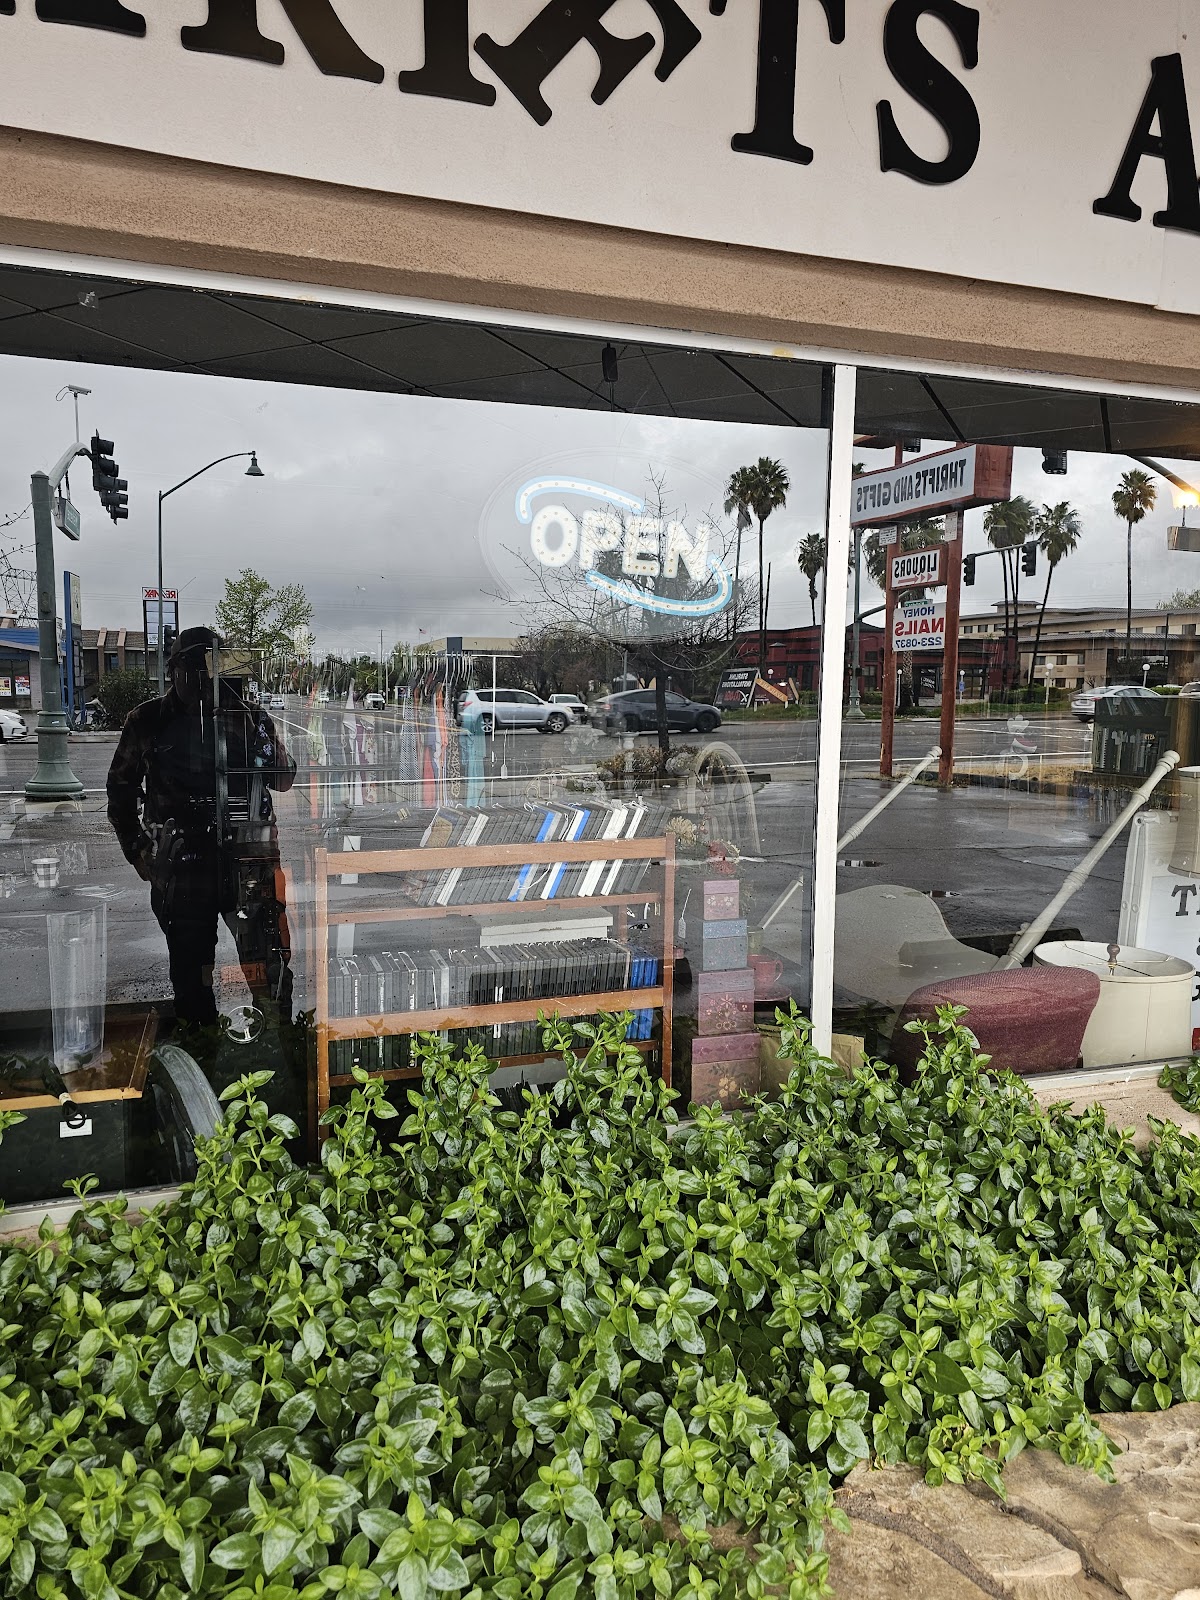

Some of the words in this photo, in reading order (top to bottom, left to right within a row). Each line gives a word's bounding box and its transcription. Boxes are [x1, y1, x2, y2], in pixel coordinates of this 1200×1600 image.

[1092, 52, 1200, 234] A
[530, 505, 711, 581] OPEN
[1171, 883, 1200, 917] T
